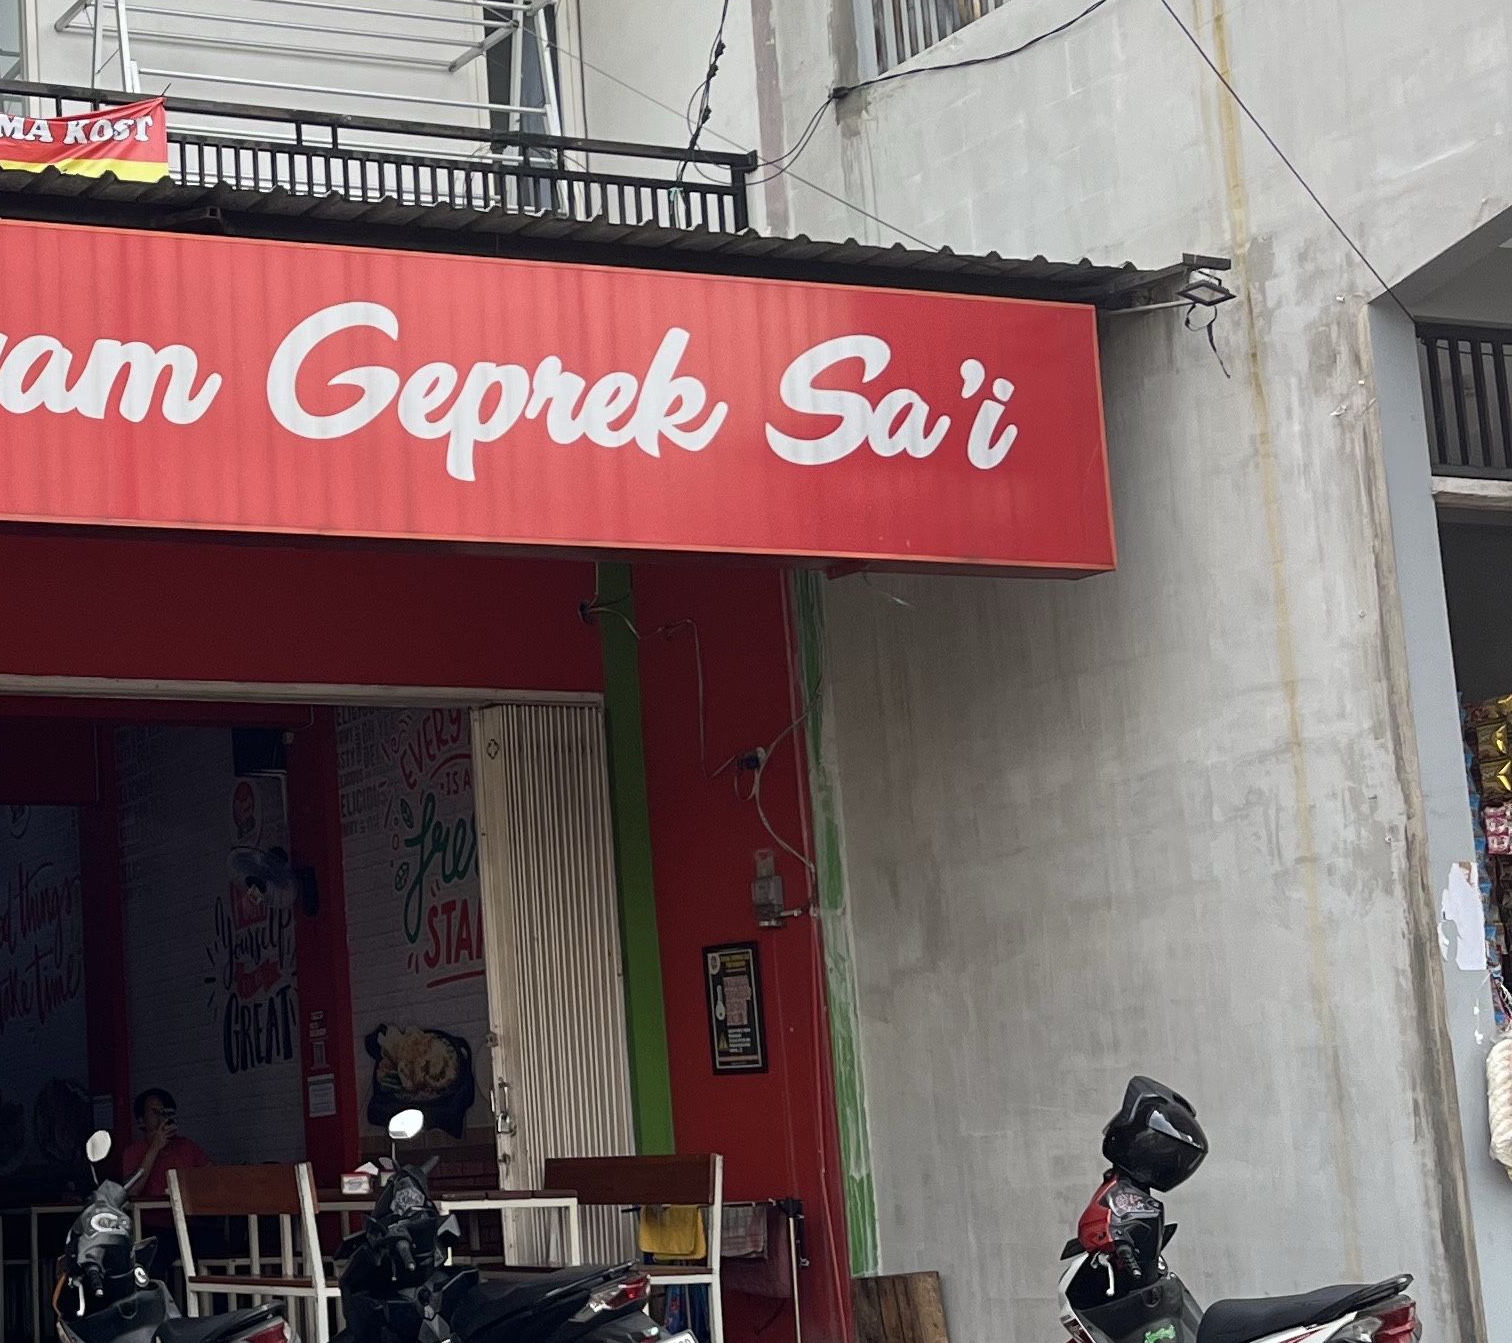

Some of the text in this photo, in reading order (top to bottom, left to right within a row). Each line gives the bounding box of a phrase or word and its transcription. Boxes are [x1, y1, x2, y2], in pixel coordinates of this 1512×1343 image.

[63, 115, 153, 145] KOST
[266, 300, 728, 482] Geprek
[765, 334, 1018, 470] Sa'i
[400, 708, 462, 790] EVERY
[445, 770, 460, 796] IS
[223, 985, 293, 1075] GREAT
